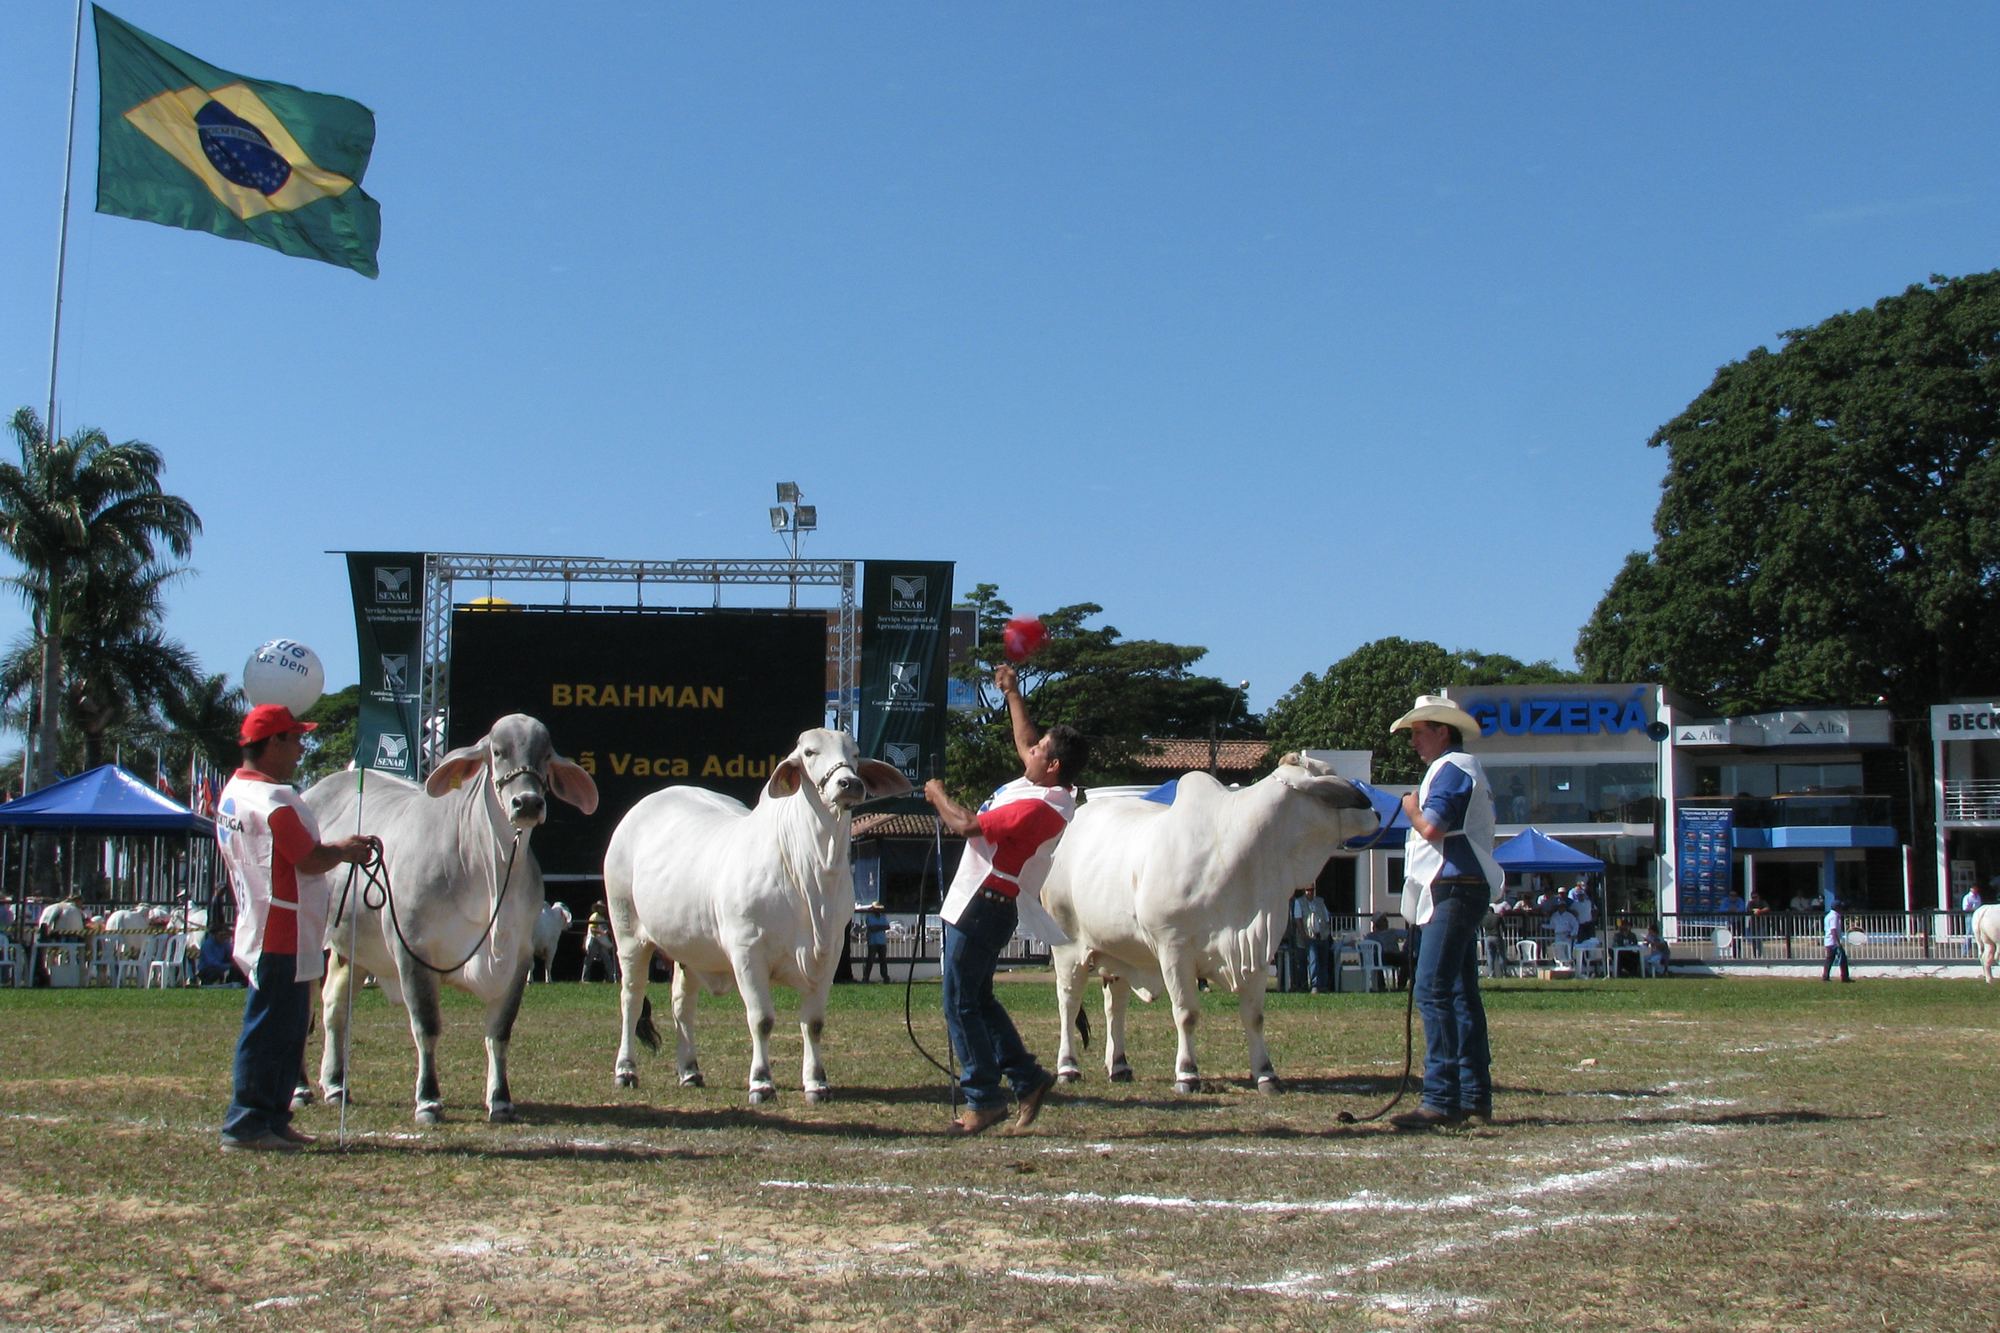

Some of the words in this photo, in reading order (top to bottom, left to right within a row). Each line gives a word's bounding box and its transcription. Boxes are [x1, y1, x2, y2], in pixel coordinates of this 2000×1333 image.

[378, 591, 408, 600] SENAR
[893, 601, 923, 609] SENAR
[280, 655, 309, 677] bem
[552, 683, 725, 709] BRAHMAN
[1468, 686, 1650, 737] GUZERÁ
[1814, 720, 1845, 735] Alta
[1700, 730, 1722, 741] Alta
[377, 758, 405, 768] SENAR
[608, 753, 689, 778] Vaca
[701, 754, 786, 779] Adul
